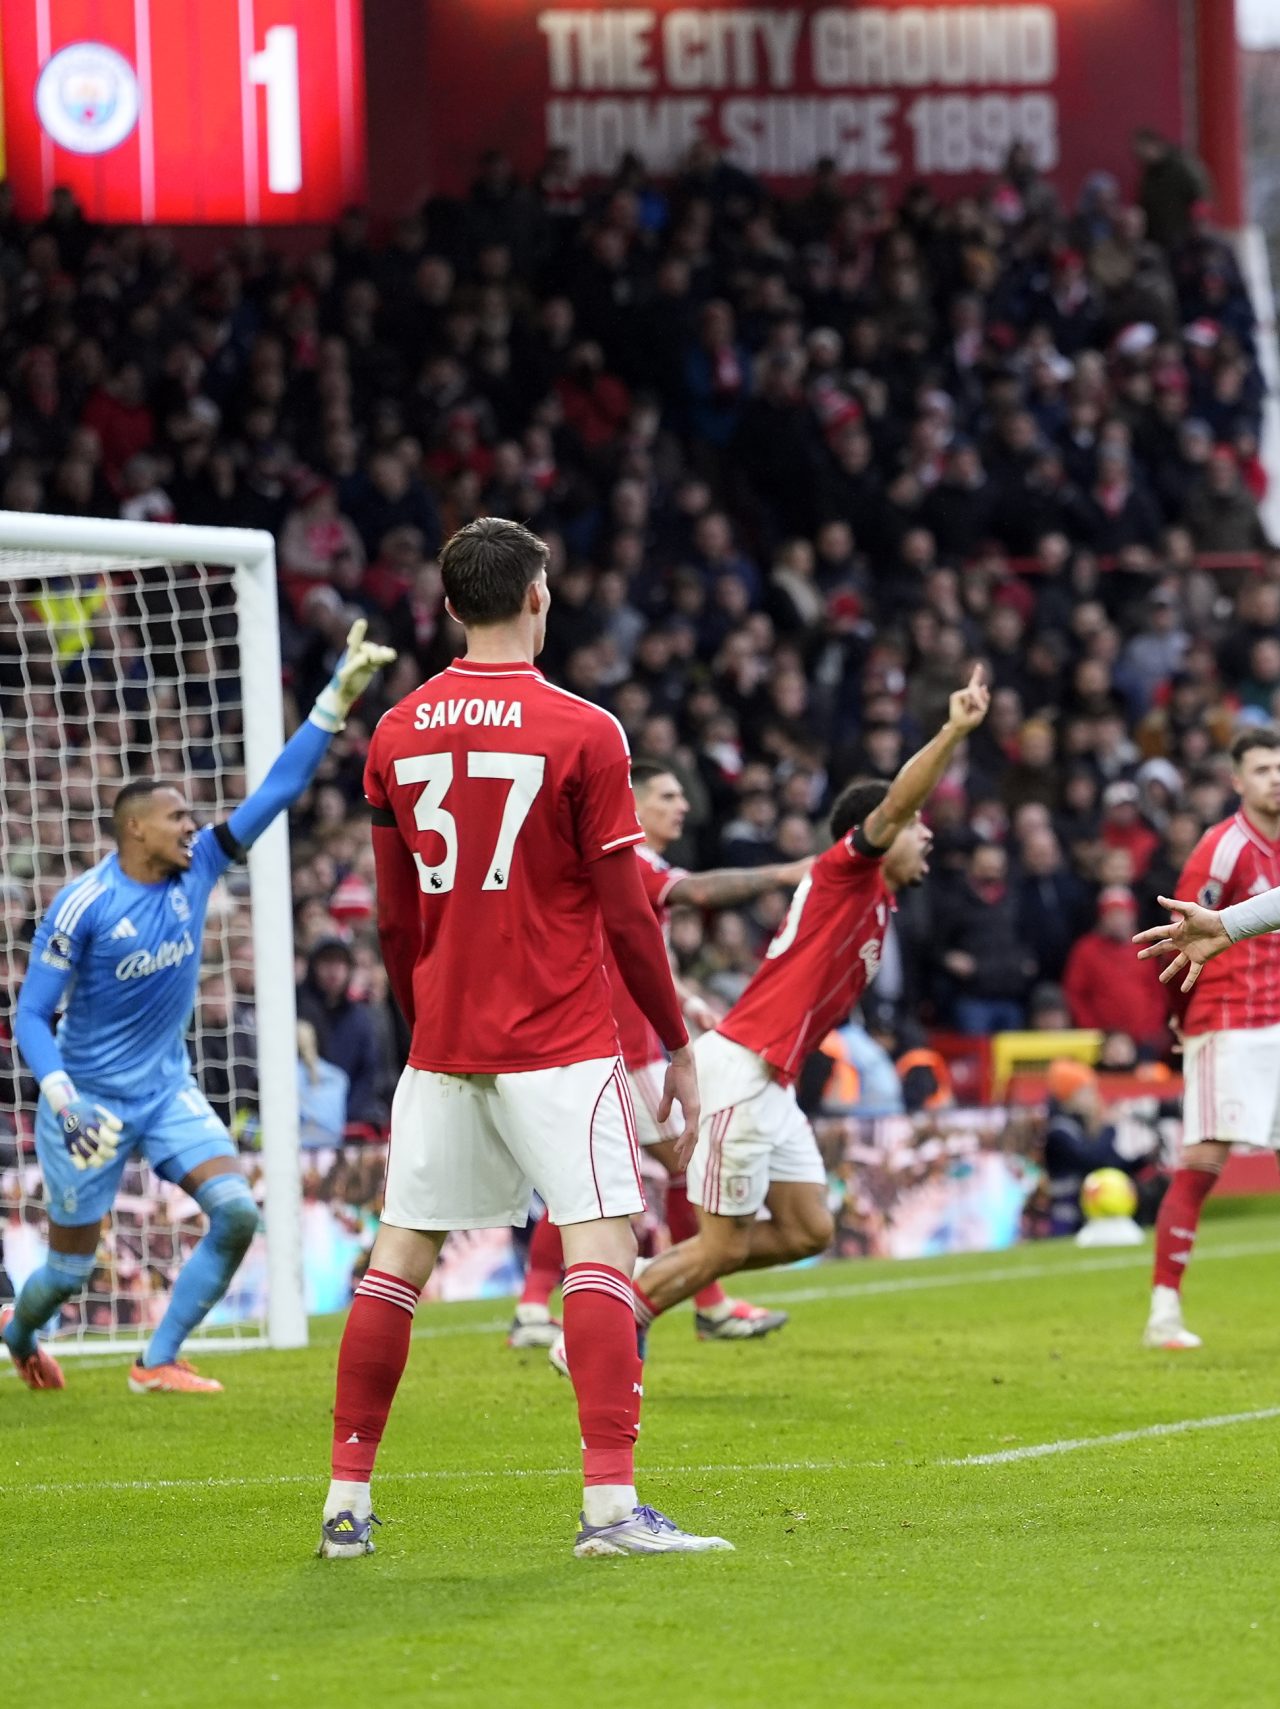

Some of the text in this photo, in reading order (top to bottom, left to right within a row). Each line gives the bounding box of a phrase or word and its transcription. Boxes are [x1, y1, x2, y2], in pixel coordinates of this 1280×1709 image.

[538, 6, 1058, 90] THE CITY GROUND
[249, 25, 302, 194] 1
[721, 95, 897, 174] SINCE
[414, 699, 522, 729] SAVONA
[394, 752, 545, 894] 37
